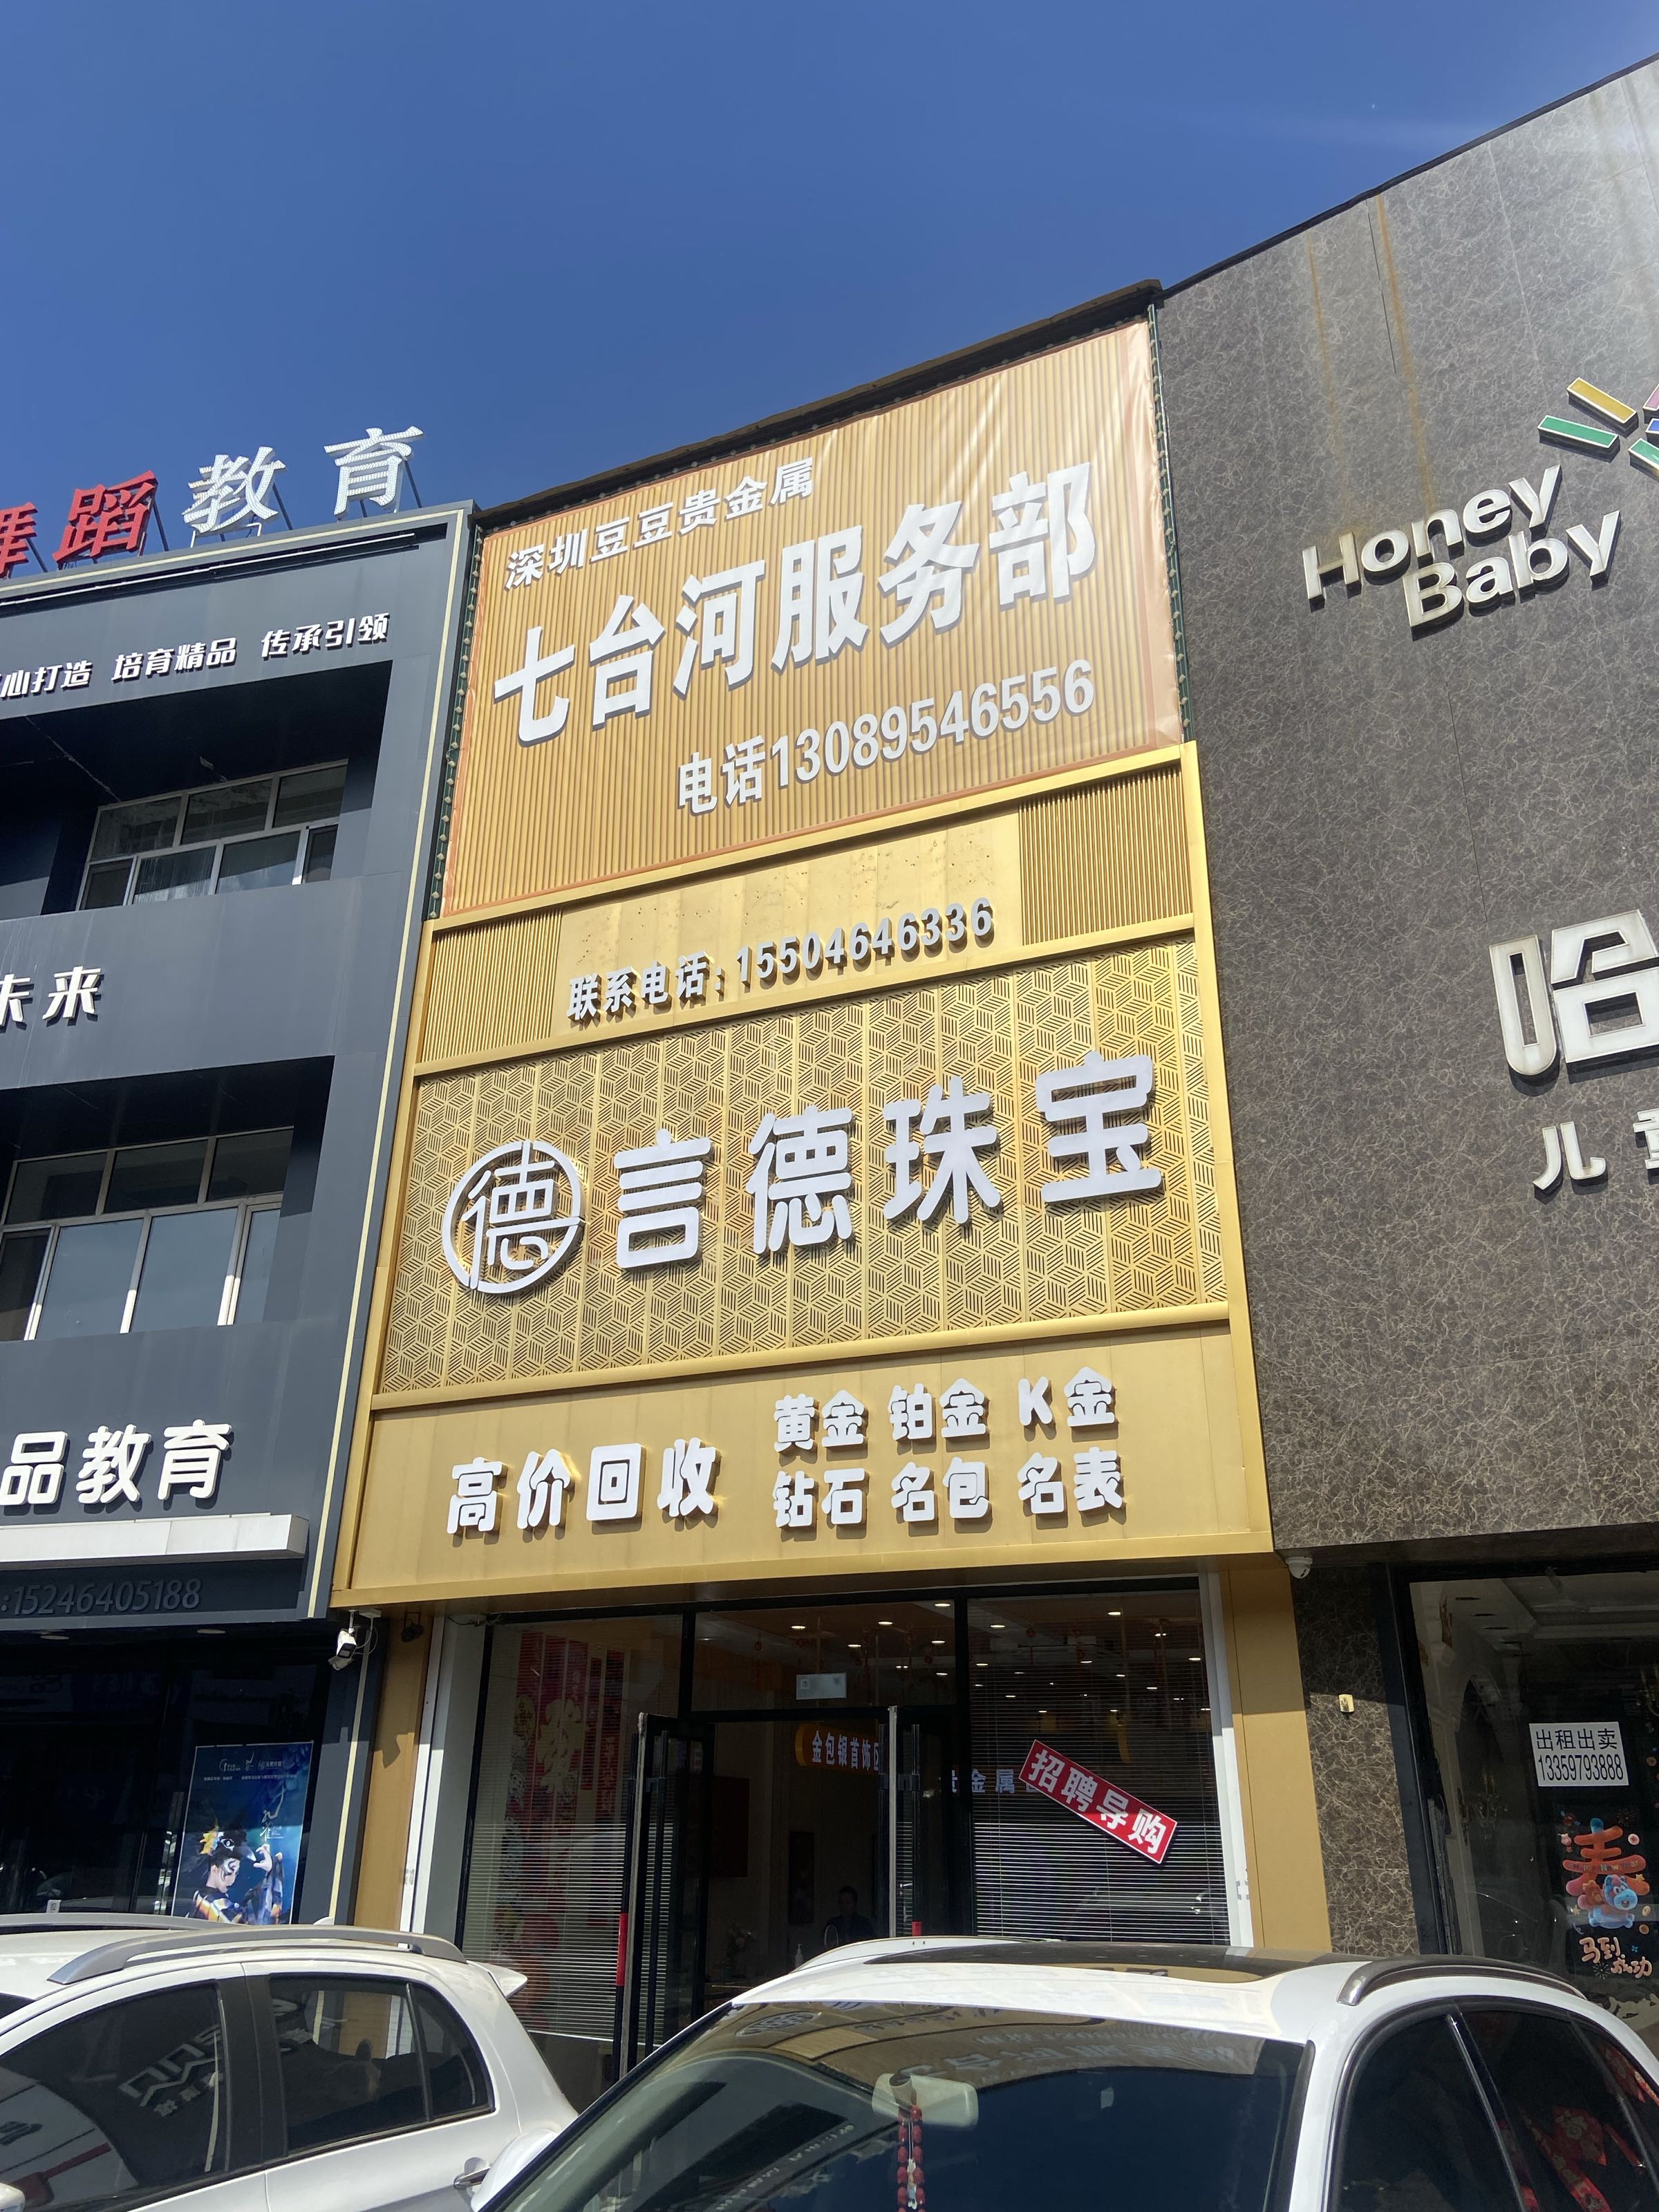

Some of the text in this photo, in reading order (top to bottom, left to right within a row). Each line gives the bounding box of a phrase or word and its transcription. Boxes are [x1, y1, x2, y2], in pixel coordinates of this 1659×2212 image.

[505, 457, 813, 590] 深圳豆豆贵金属
[1302, 465, 1561, 600] Honey
[1403, 510, 1620, 628] Baby
[494, 462, 1096, 744] 七台河服务部
[0, 612, 390, 698] 心打造 培育精品 传承引领
[678, 659, 1094, 814] 电话13089546556
[614, 1050, 1163, 1268] 言德珠宝
[774, 1366, 1116, 1452] 黄金 铂金 K金
[0, 1419, 232, 1506] 品教育
[447, 1437, 718, 1535] 高价回收
[772, 1446, 1125, 1528] 钻石 名包 名表
[1536, 1728, 1618, 1750] 出租出卖
[1539, 1754, 1624, 1781] 13359793888
[1028, 1749, 1167, 1855] 招聘导购
[1579, 1936, 1621, 1964] 马到
